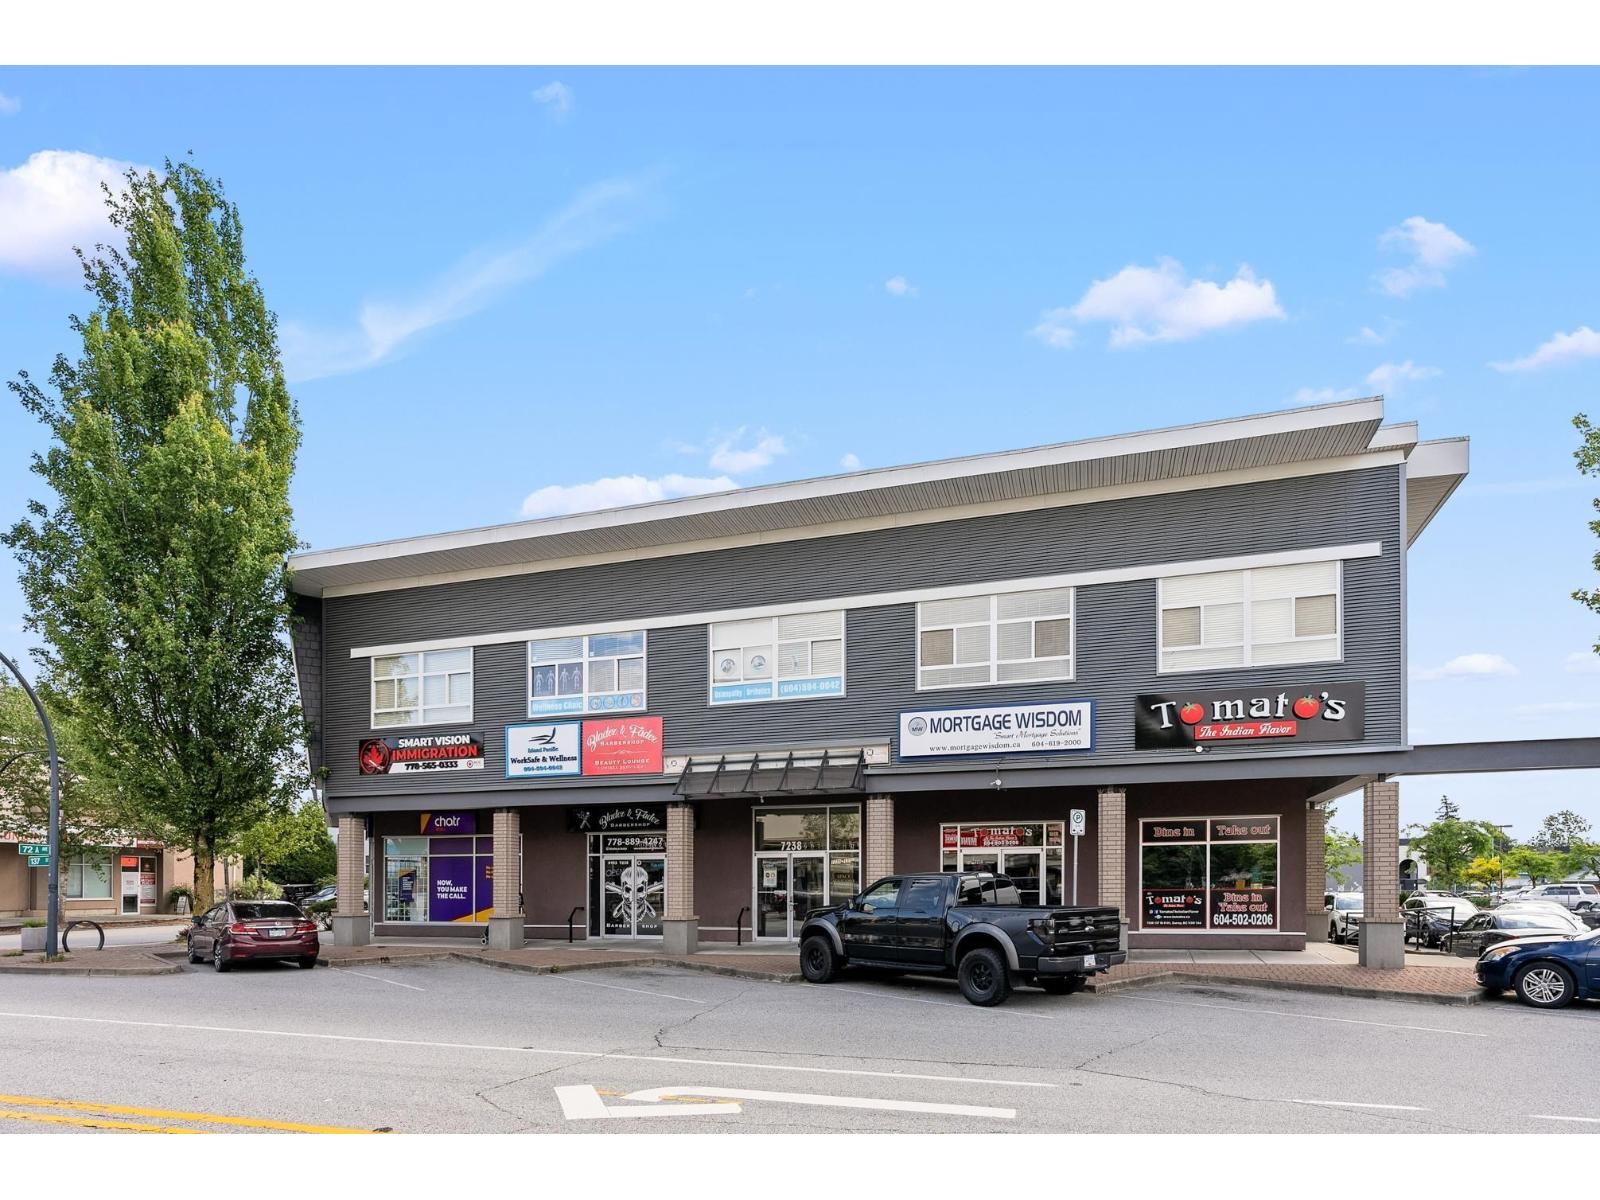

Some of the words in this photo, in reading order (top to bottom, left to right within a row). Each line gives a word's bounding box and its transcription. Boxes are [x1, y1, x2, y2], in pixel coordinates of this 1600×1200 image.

[929, 713, 1012, 734] MORTGAGE
[1015, 709, 1082, 729] WISDOM
[1199, 726, 1216, 737] The
[1220, 725, 1254, 737] Indian
[1259, 722, 1292, 735] Flavor
[398, 737, 433, 748] SMART
[435, 735, 471, 747] VISION
[929, 741, 1021, 752] www.mortgagewisdom.ca
[392, 745, 478, 761] IMMIGRATION
[510, 756, 540, 764] WorkSafe
[548, 754, 577, 763] Wellness
[404, 761, 459, 771] 778-565-0333
[434, 815, 461, 827] chatr
[1153, 826, 1181, 838] Dine
[1183, 826, 1195, 837] in
[1216, 825, 1248, 836] Take
[1250, 824, 1271, 835] out
[780, 841, 802, 851] 7238
[30, 857, 41, 865] 137
[1223, 892, 1249, 902] Dine
[1251, 892, 1263, 902] in
[1218, 902, 1248, 912] Take
[1249, 901, 1268, 912] out
[1213, 913, 1273, 926] 604-502-0206
